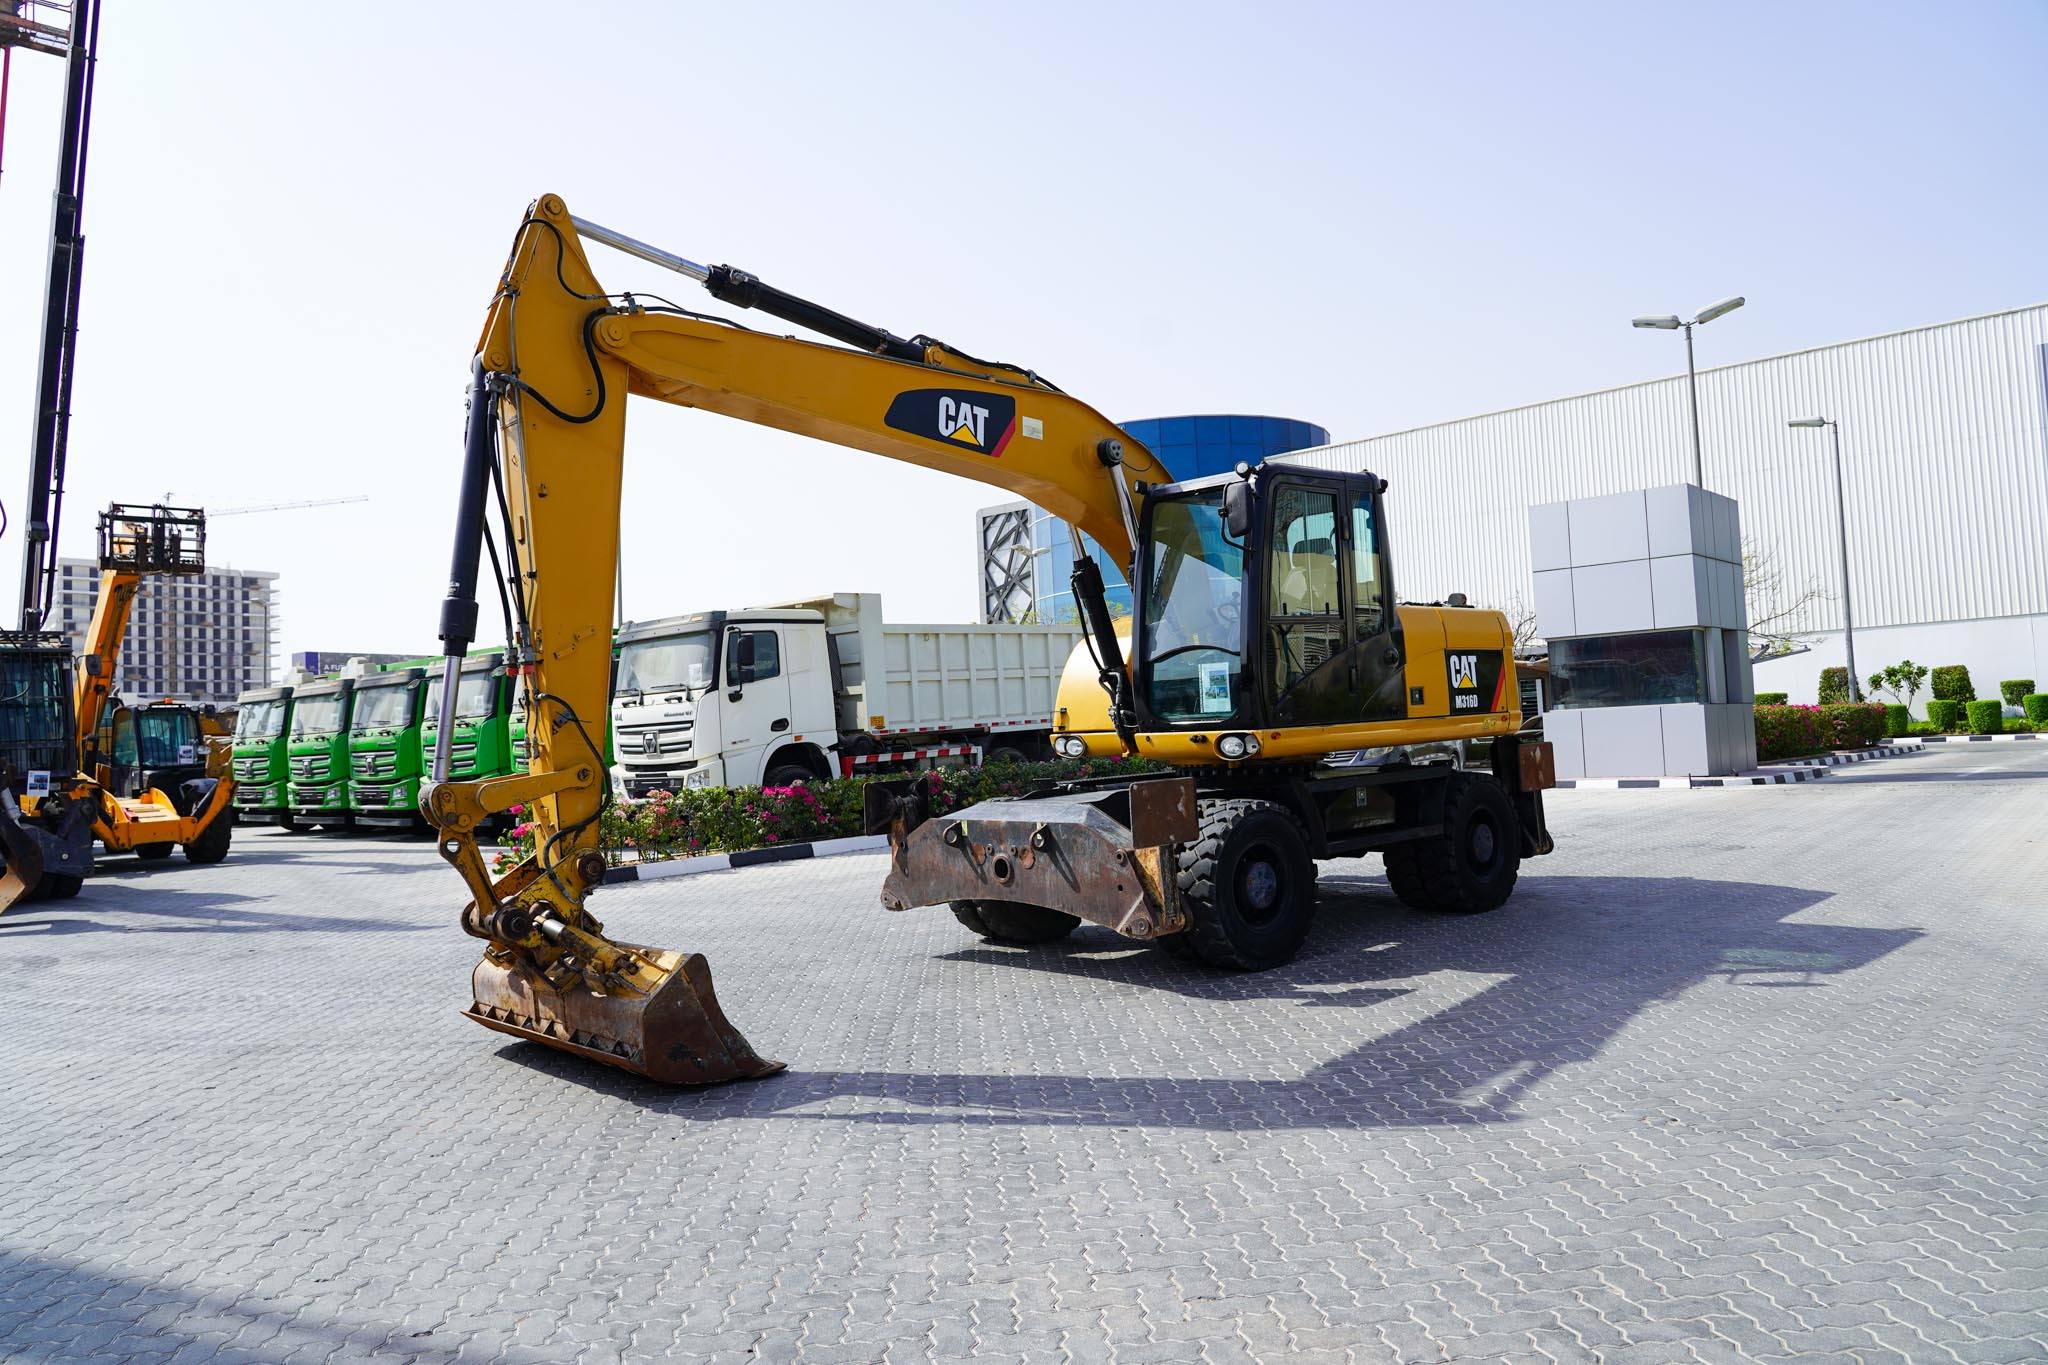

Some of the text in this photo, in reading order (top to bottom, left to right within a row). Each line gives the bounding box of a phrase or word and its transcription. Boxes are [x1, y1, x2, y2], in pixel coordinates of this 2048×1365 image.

[938, 396, 989, 447] CAT
[1449, 655, 1478, 688] CAT
[1455, 694, 1479, 709] M316D
